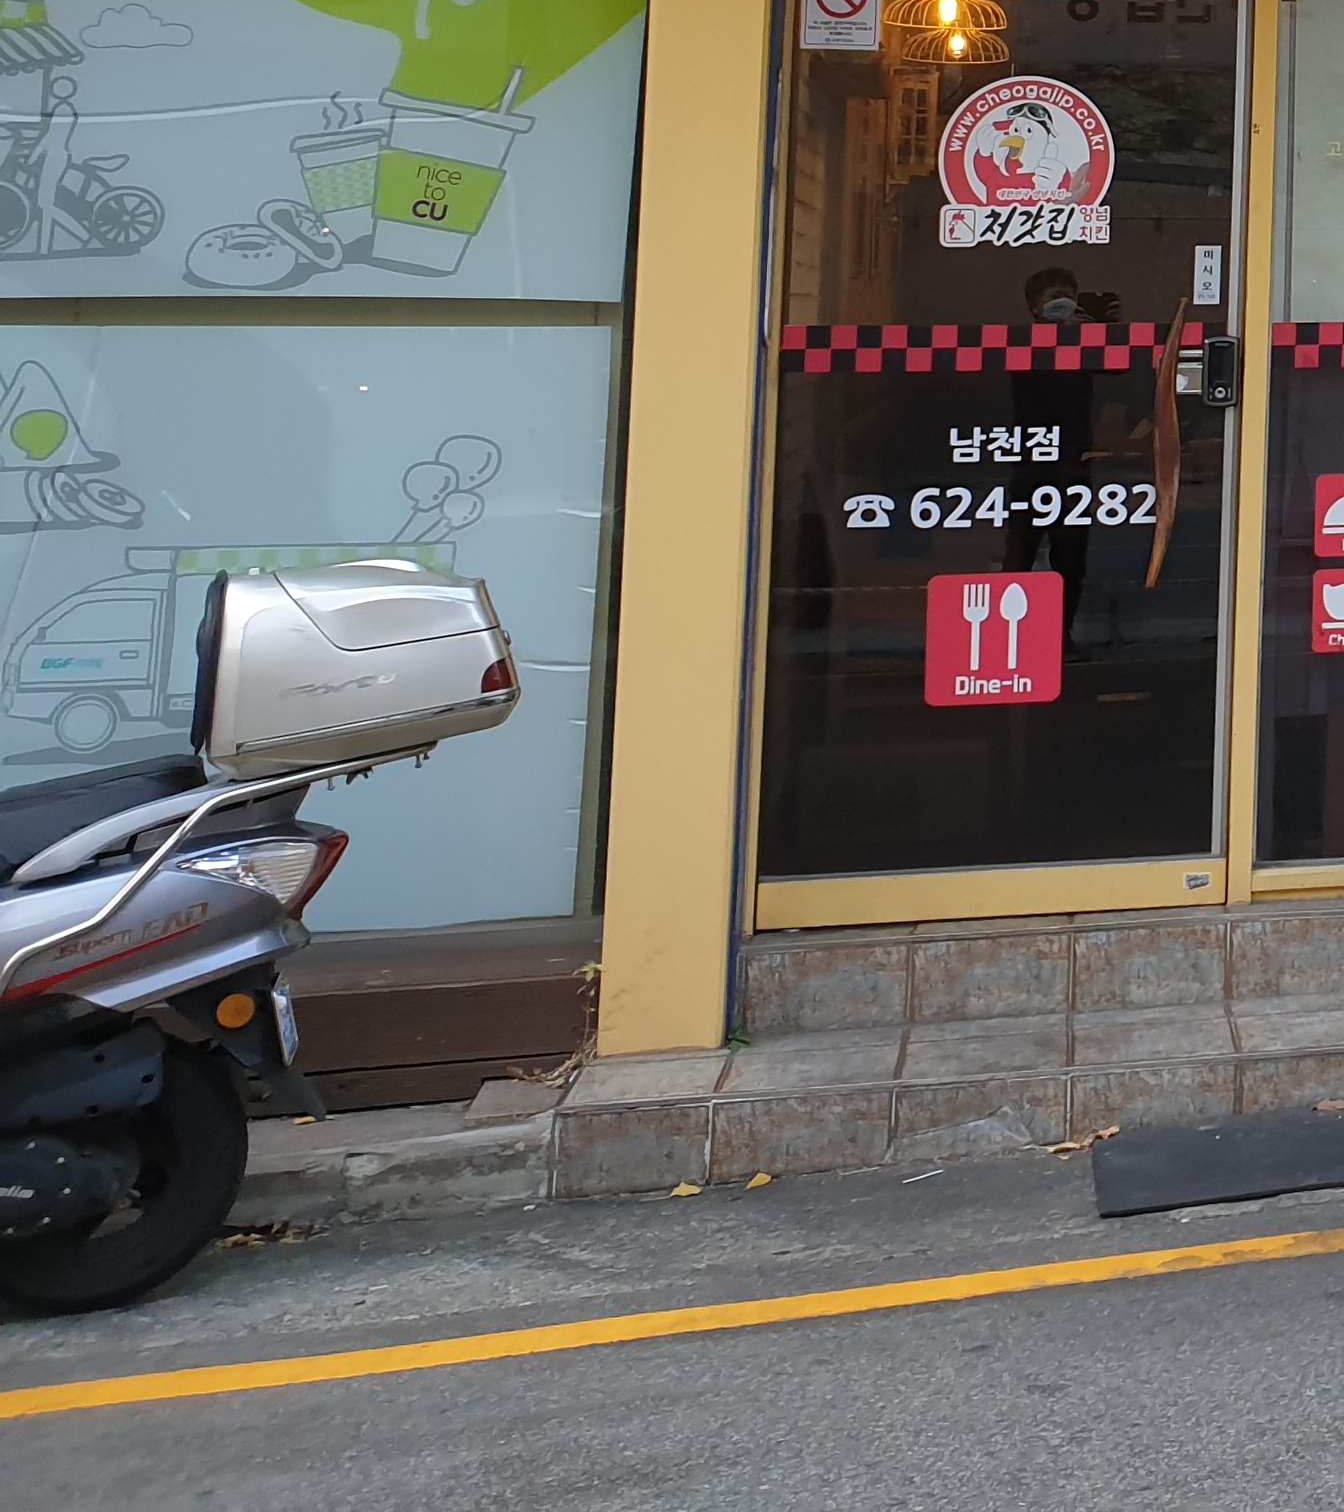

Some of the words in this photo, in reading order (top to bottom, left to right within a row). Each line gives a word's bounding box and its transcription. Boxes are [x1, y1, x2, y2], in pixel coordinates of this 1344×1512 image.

[949, 85, 1105, 151] www.cheogajip.co.kr
[417, 163, 461, 186] nice
[423, 182, 446, 201] to
[412, 200, 449, 221] CU
[1080, 207, 1108, 222] 양념
[980, 204, 1075, 243] 처갓집
[1080, 225, 1108, 241] 치킨
[950, 425, 1060, 463] 남천점
[910, 483, 1157, 529] 624-9282
[955, 674, 1032, 696] Dine-in
